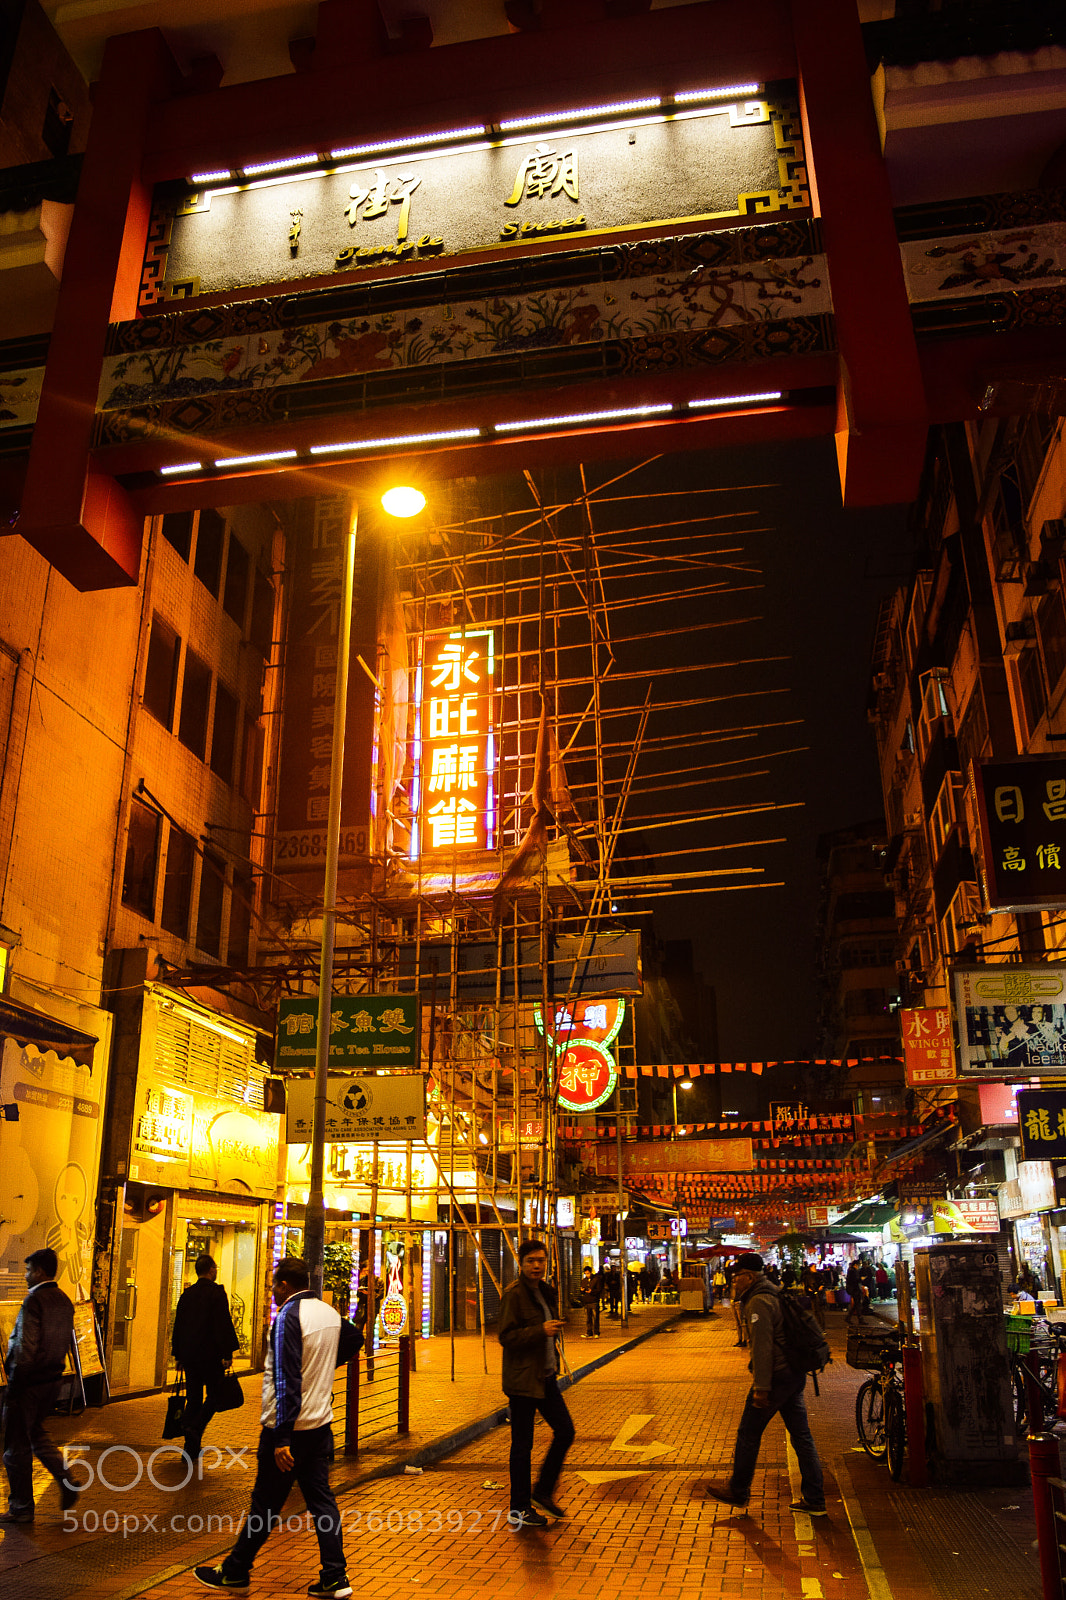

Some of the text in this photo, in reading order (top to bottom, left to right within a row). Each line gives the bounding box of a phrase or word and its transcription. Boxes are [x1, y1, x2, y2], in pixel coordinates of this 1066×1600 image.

[335, 213, 588, 262] Temple Street
[428, 643, 480, 848] 永旺麻雀
[1002, 843, 1061, 871] 高價
[347, 1044, 370, 1055] Tea
[373, 1043, 411, 1055] House
[908, 1039, 939, 1049] WING
[965, 1215, 980, 1223] CITY
